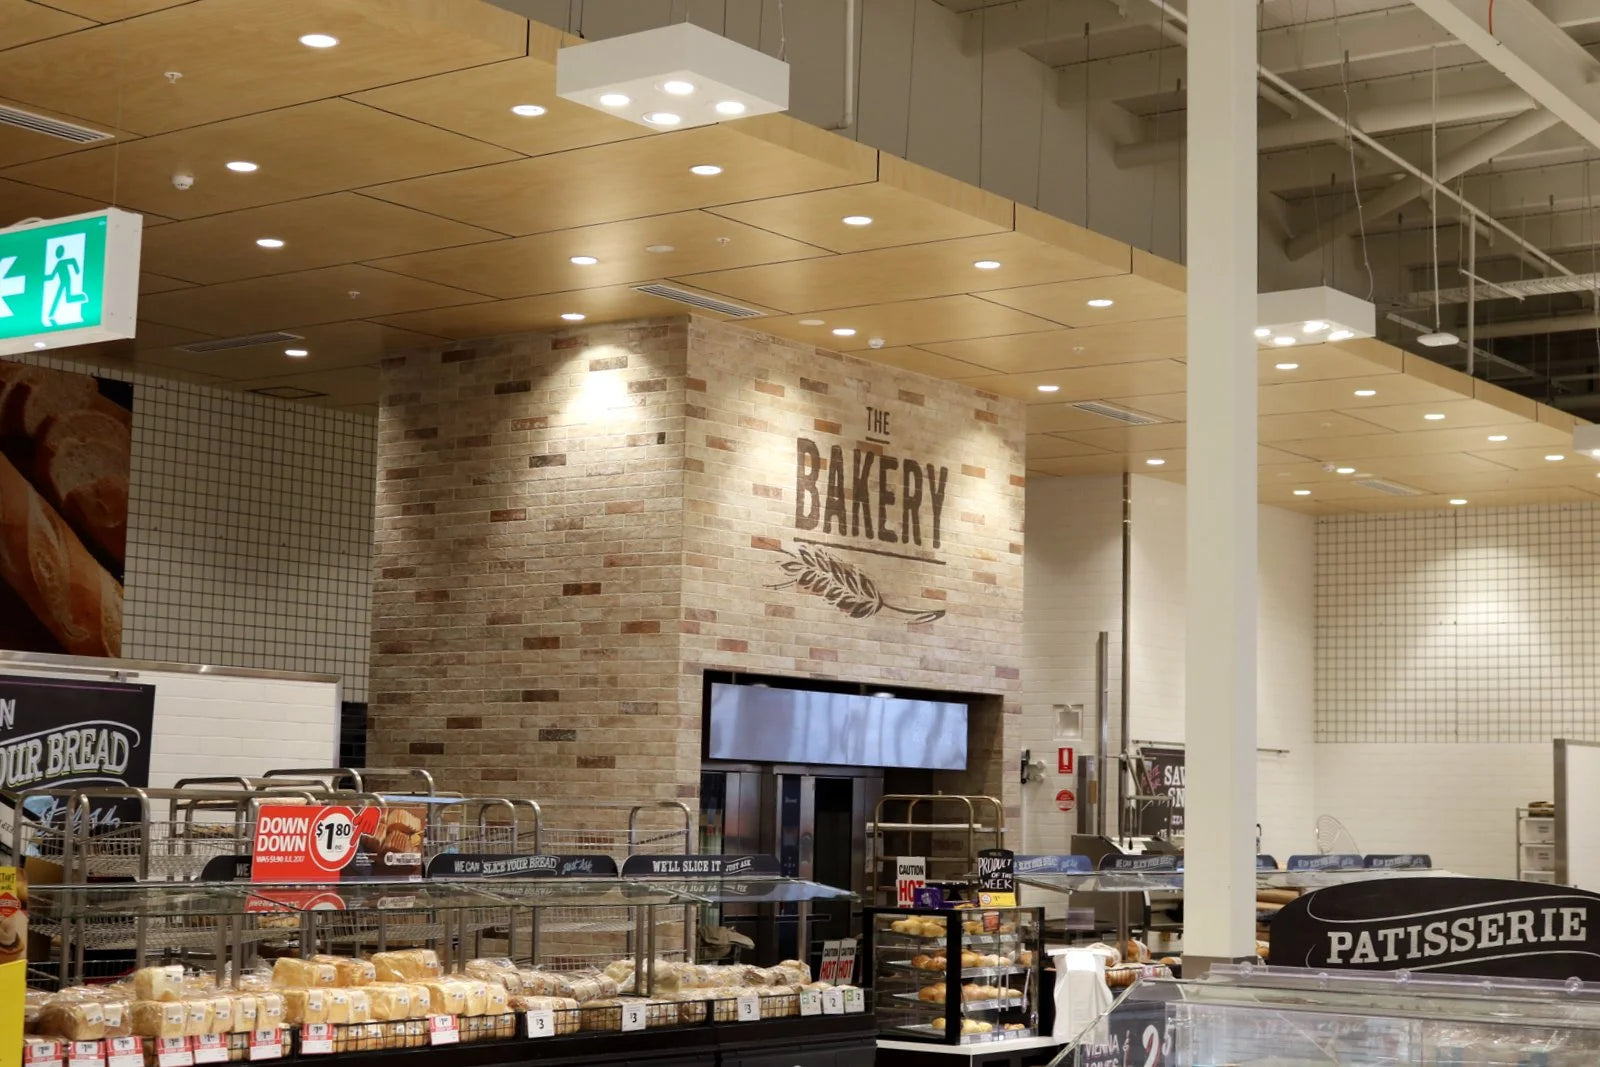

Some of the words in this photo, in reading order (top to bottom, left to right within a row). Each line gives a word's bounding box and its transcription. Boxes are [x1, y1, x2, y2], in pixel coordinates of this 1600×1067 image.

[866, 406, 890, 435] THE
[795, 437, 949, 549] BAKERY
[45, 728, 130, 776] BREAD
[259, 817, 309, 834] DOWN
[257, 835, 306, 852] DOWN
[454, 861, 466, 873] WE
[467, 861, 480, 872] CAN
[483, 862, 506, 874] SLICE
[507, 859, 528, 871] YOUR
[529, 857, 557, 869] BREAD
[652, 860, 680, 872] WE'LL
[682, 861, 709, 872] SLICE
[711, 860, 722, 871] IT
[725, 862, 739, 872] JUST
[740, 859, 751, 868] ASK
[898, 864, 923, 876] CAUTION
[978, 857, 1012, 879] PRODUCT
[980, 879, 1013, 889] WEEK
[1326, 907, 1587, 964] PATISSERIE
[821, 960, 837, 980] HOT
[838, 960, 853, 979] HOT
[1085, 1034, 1120, 1057] VIENNA
